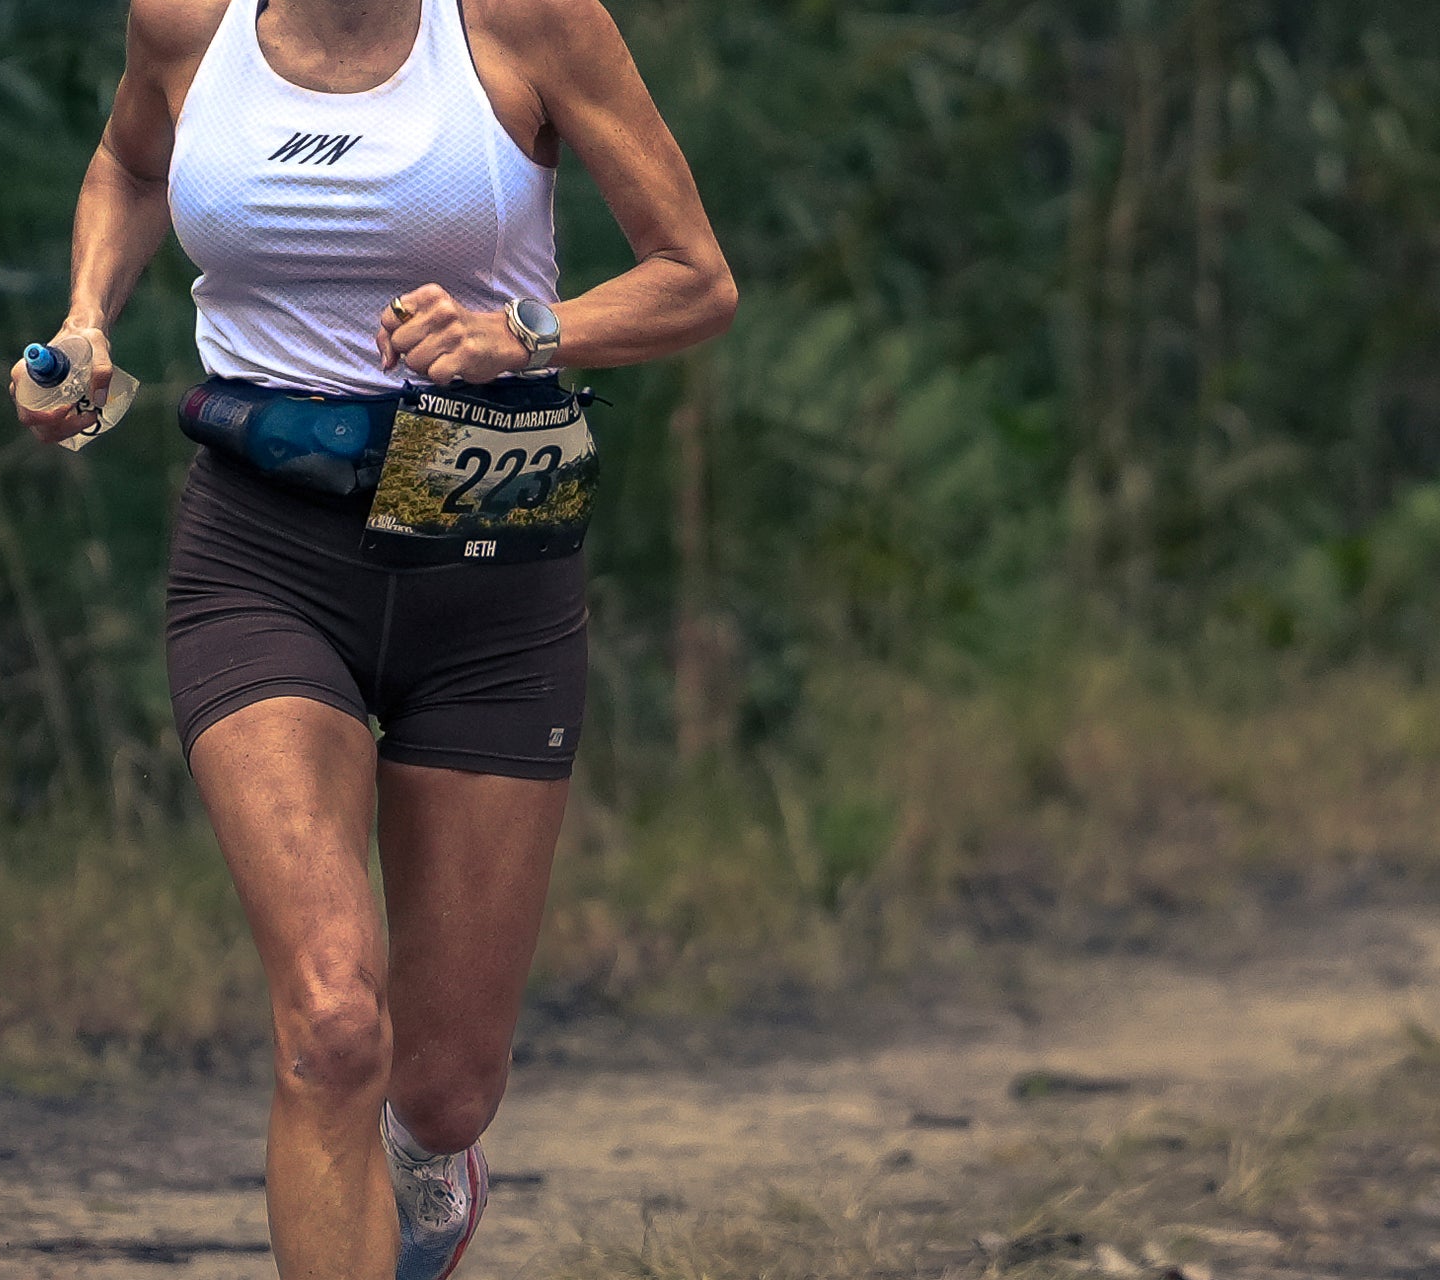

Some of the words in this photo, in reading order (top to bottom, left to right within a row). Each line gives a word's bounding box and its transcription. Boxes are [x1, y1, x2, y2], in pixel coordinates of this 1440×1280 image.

[267, 132, 364, 166] WYN
[418, 394, 471, 420] SYDNEY
[471, 404, 511, 429] ULTRA
[513, 407, 569, 429] MARATHON
[440, 444, 563, 515] 223
[463, 540, 497, 557] BETH
